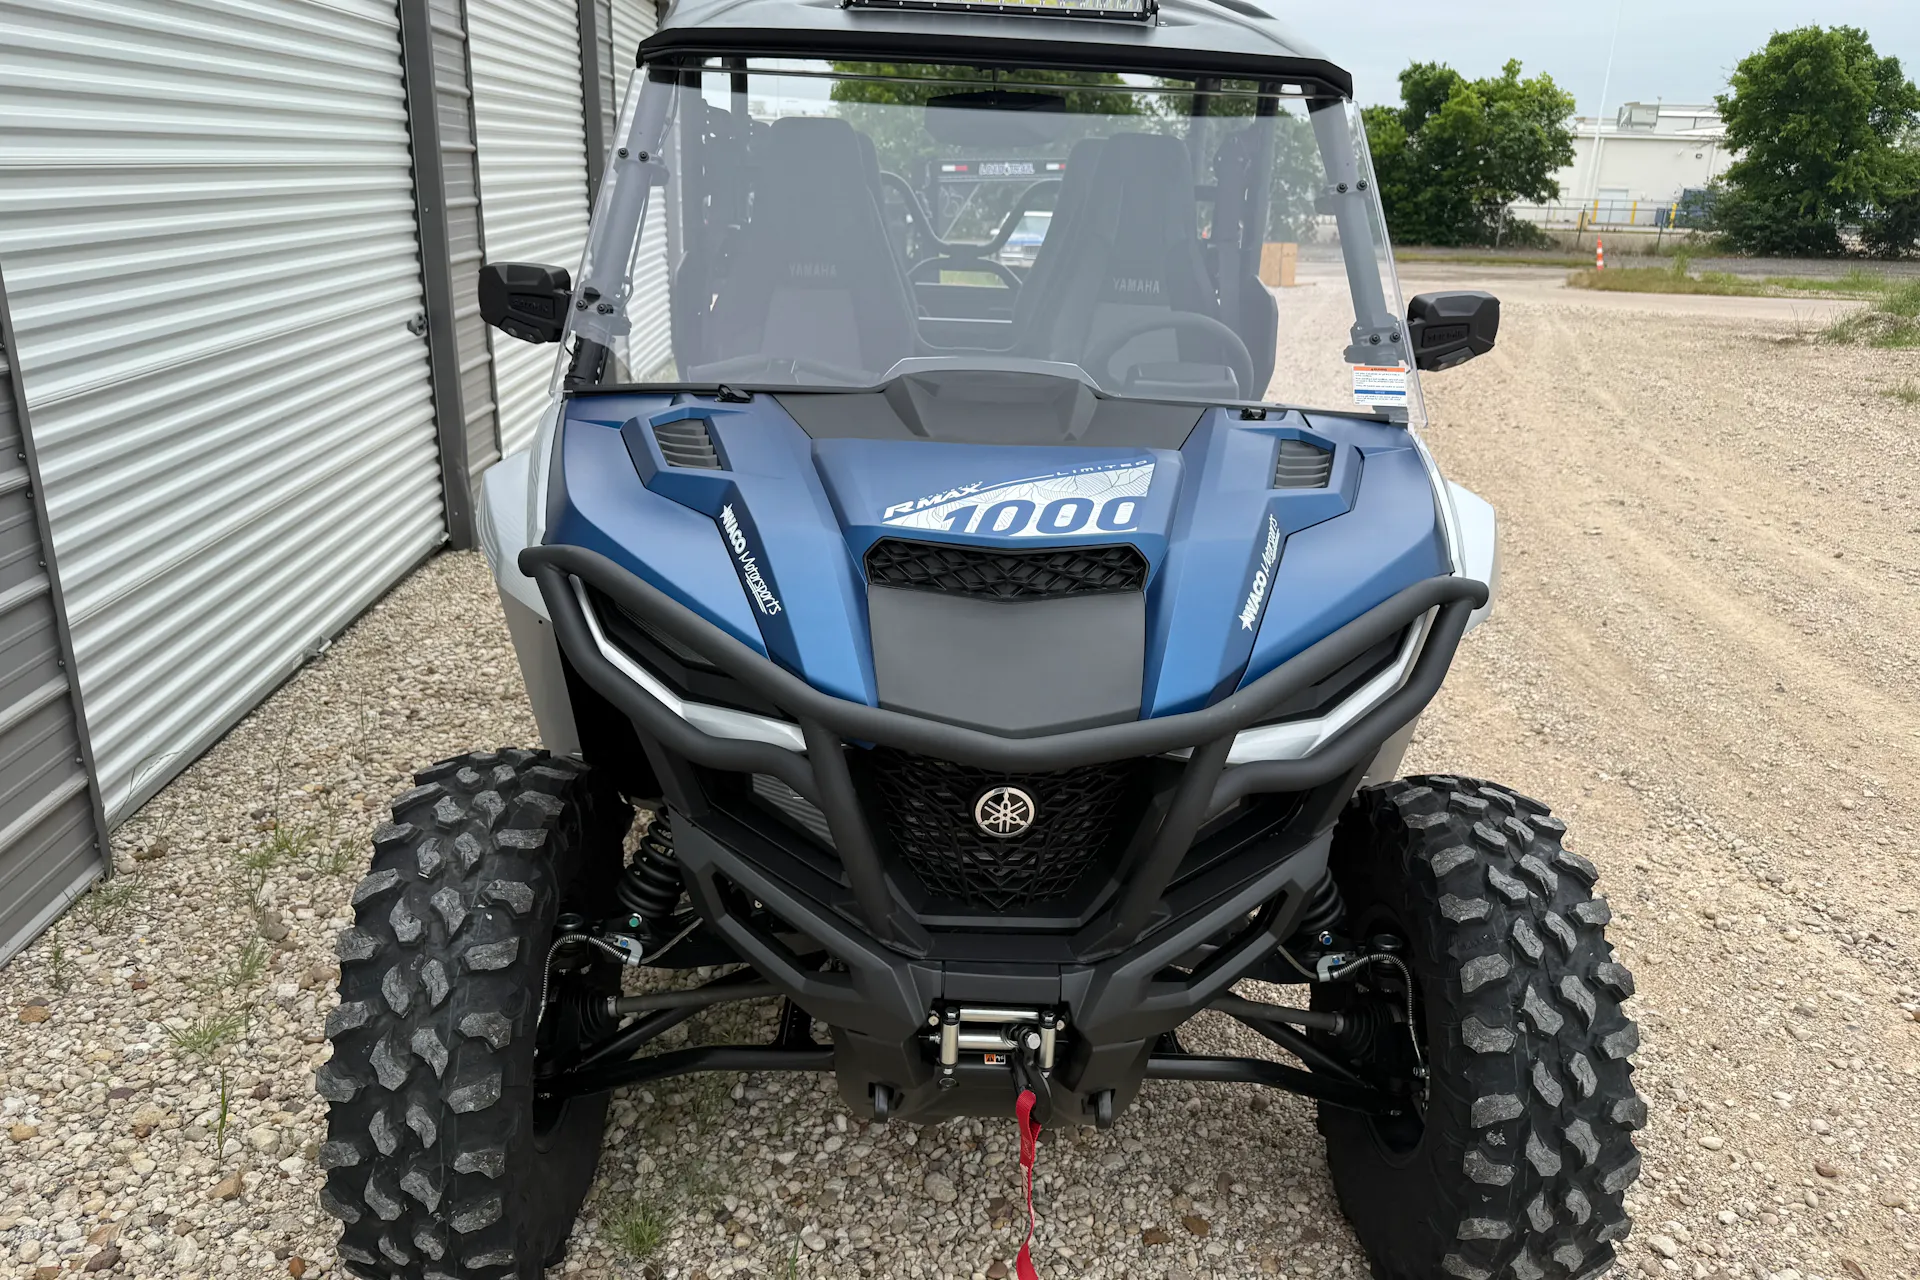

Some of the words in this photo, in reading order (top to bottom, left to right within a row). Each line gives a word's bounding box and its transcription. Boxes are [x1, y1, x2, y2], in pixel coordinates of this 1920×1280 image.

[789, 261, 838, 279] YAMAHA
[1111, 275, 1161, 294] YAMAHA
[883, 481, 983, 519] RMAX
[944, 496, 1146, 535] 1000
[722, 507, 747, 554] WACO
[739, 551, 782, 615] Motorsports
[1242, 570, 1267, 622] WACO
